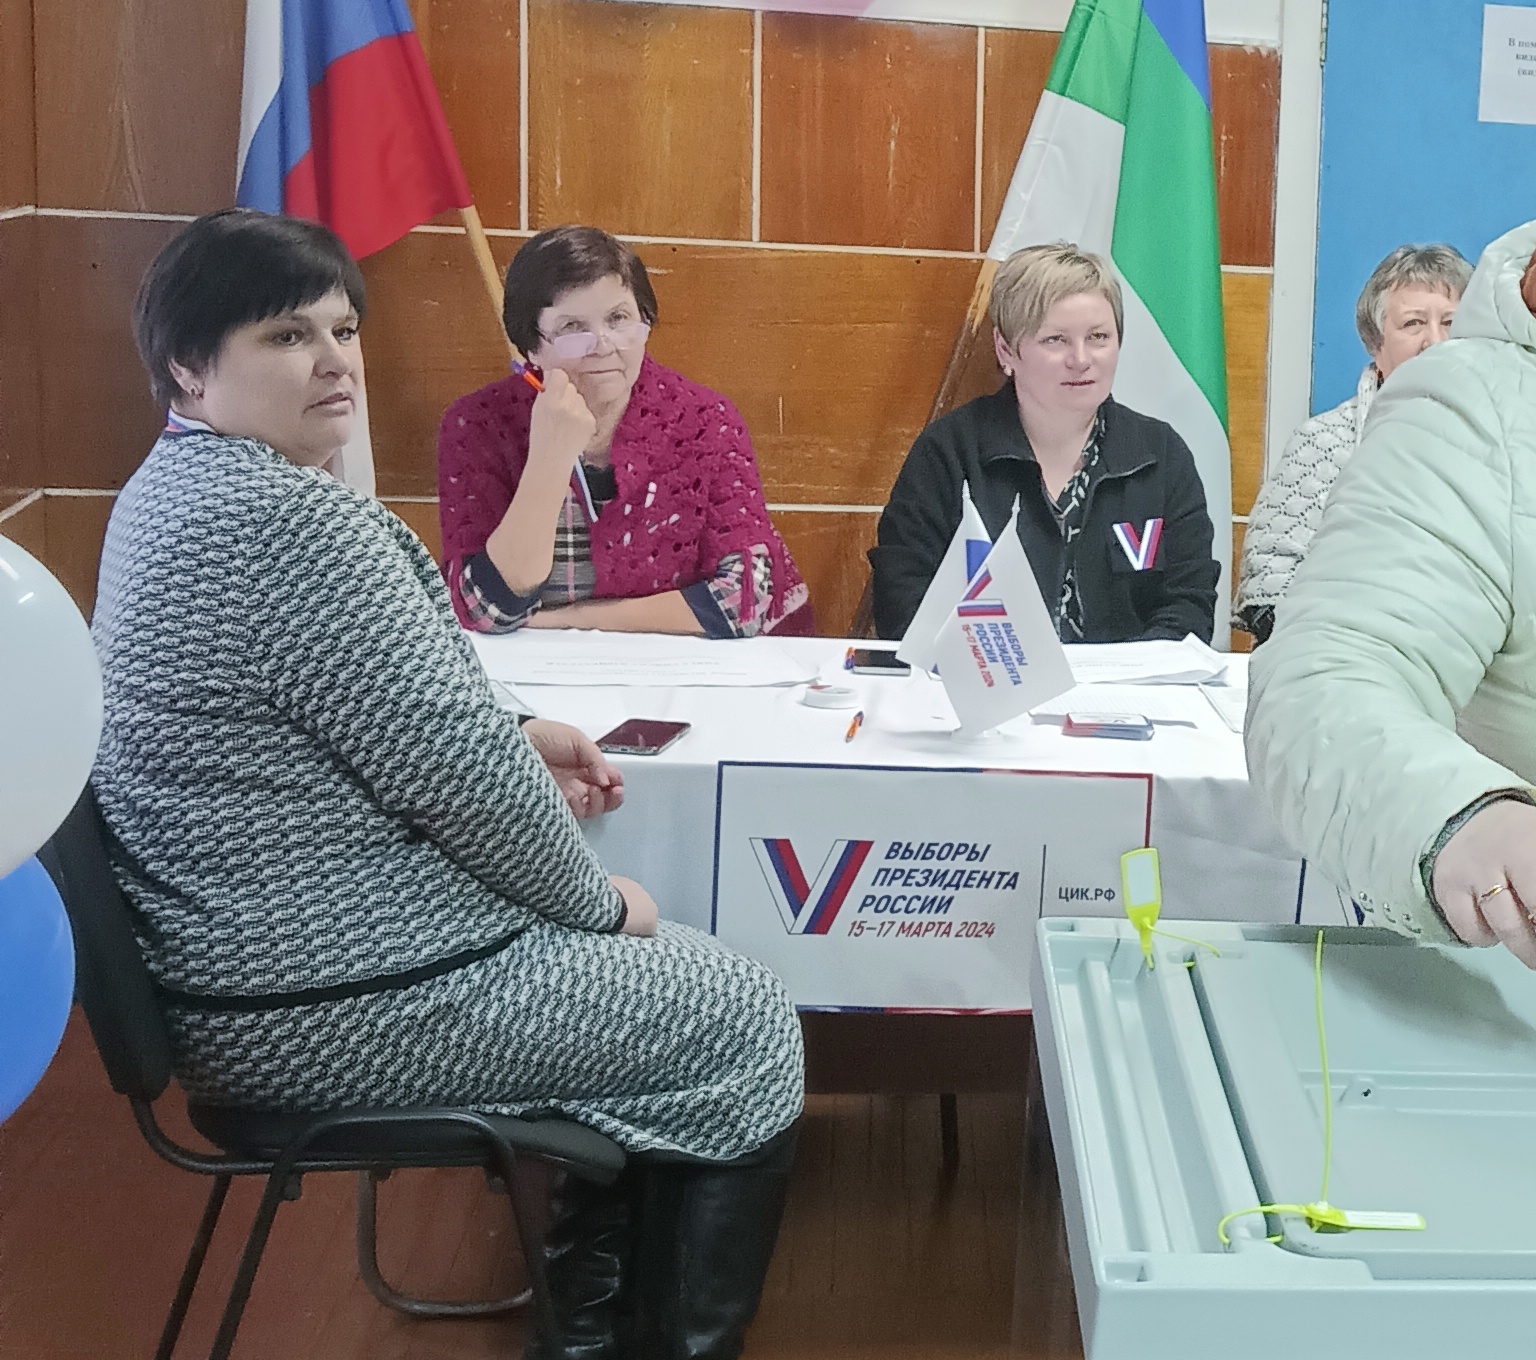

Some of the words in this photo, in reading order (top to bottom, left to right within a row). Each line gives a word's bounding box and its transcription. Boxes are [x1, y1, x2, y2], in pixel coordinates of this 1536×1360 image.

[1508, 38, 1515, 46] В
[973, 622, 998, 663] РОССИИ
[1001, 622, 1028, 666] ВЫБОРЫ
[987, 622, 1023, 687] ПРЕЗИДЕНТА
[970, 644, 985, 671] МАРТА
[980, 669, 995, 688] 2024
[884, 841, 991, 862] ВЫБОРЫ
[871, 868, 1020, 892] ПРЕЗИДЕНТА
[857, 894, 954, 915] РОССИИ
[1058, 885, 1116, 902] ЦИК.РФ
[899, 921, 954, 938] МАРТА
[954, 921, 997, 938] 2024
